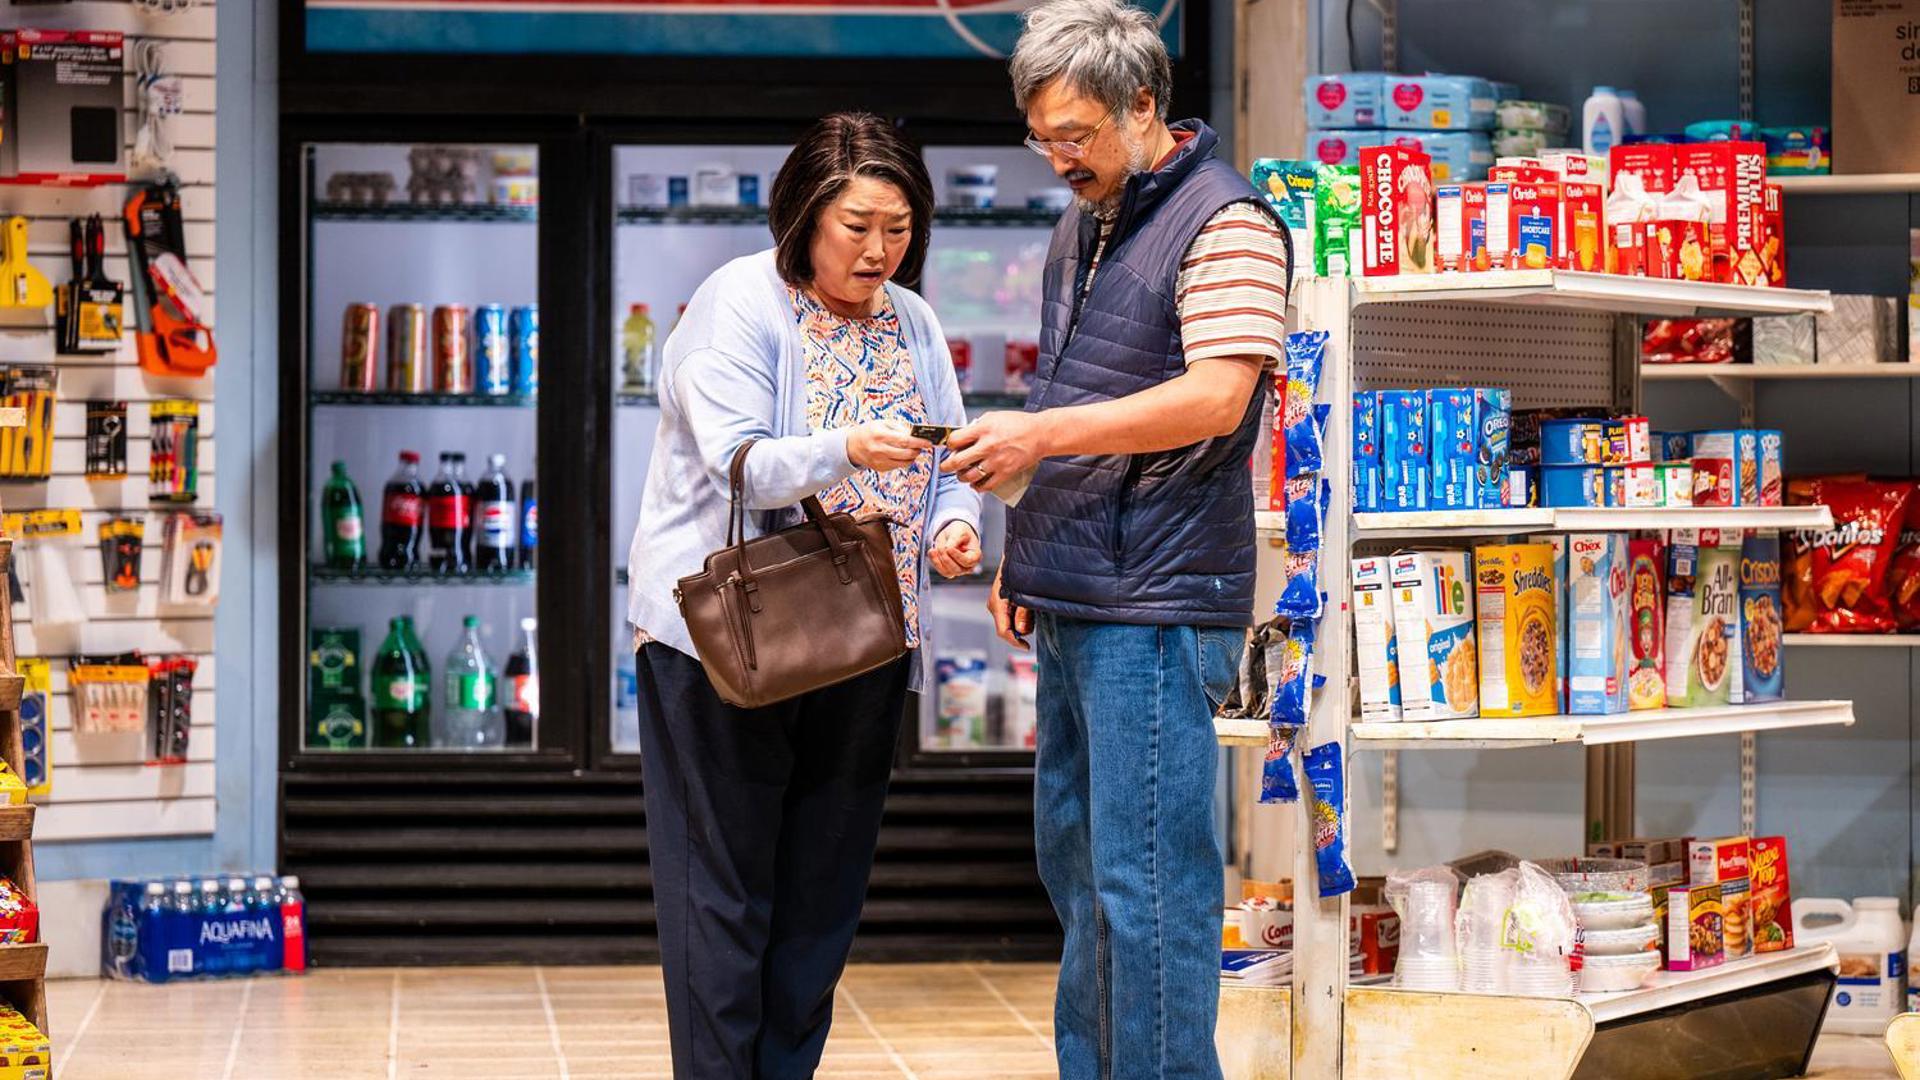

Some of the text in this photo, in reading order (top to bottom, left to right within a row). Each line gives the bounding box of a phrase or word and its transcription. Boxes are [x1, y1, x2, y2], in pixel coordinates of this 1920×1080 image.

[1901, 42, 1920, 61] d
[1749, 153, 1763, 204] PLUS
[1736, 153, 1751, 251] PREMIUM
[1484, 416, 1509, 436] OREO
[1573, 540, 1602, 553] Chex
[1812, 521, 1884, 548] Doritos
[1433, 565, 1465, 615] life
[1513, 565, 1552, 596] Shreddies
[1701, 585, 1733, 616] Bran
[1748, 846, 1779, 881] Stove
[1757, 865, 1777, 889] Top
[199, 917, 275, 945] AQUAFINA
